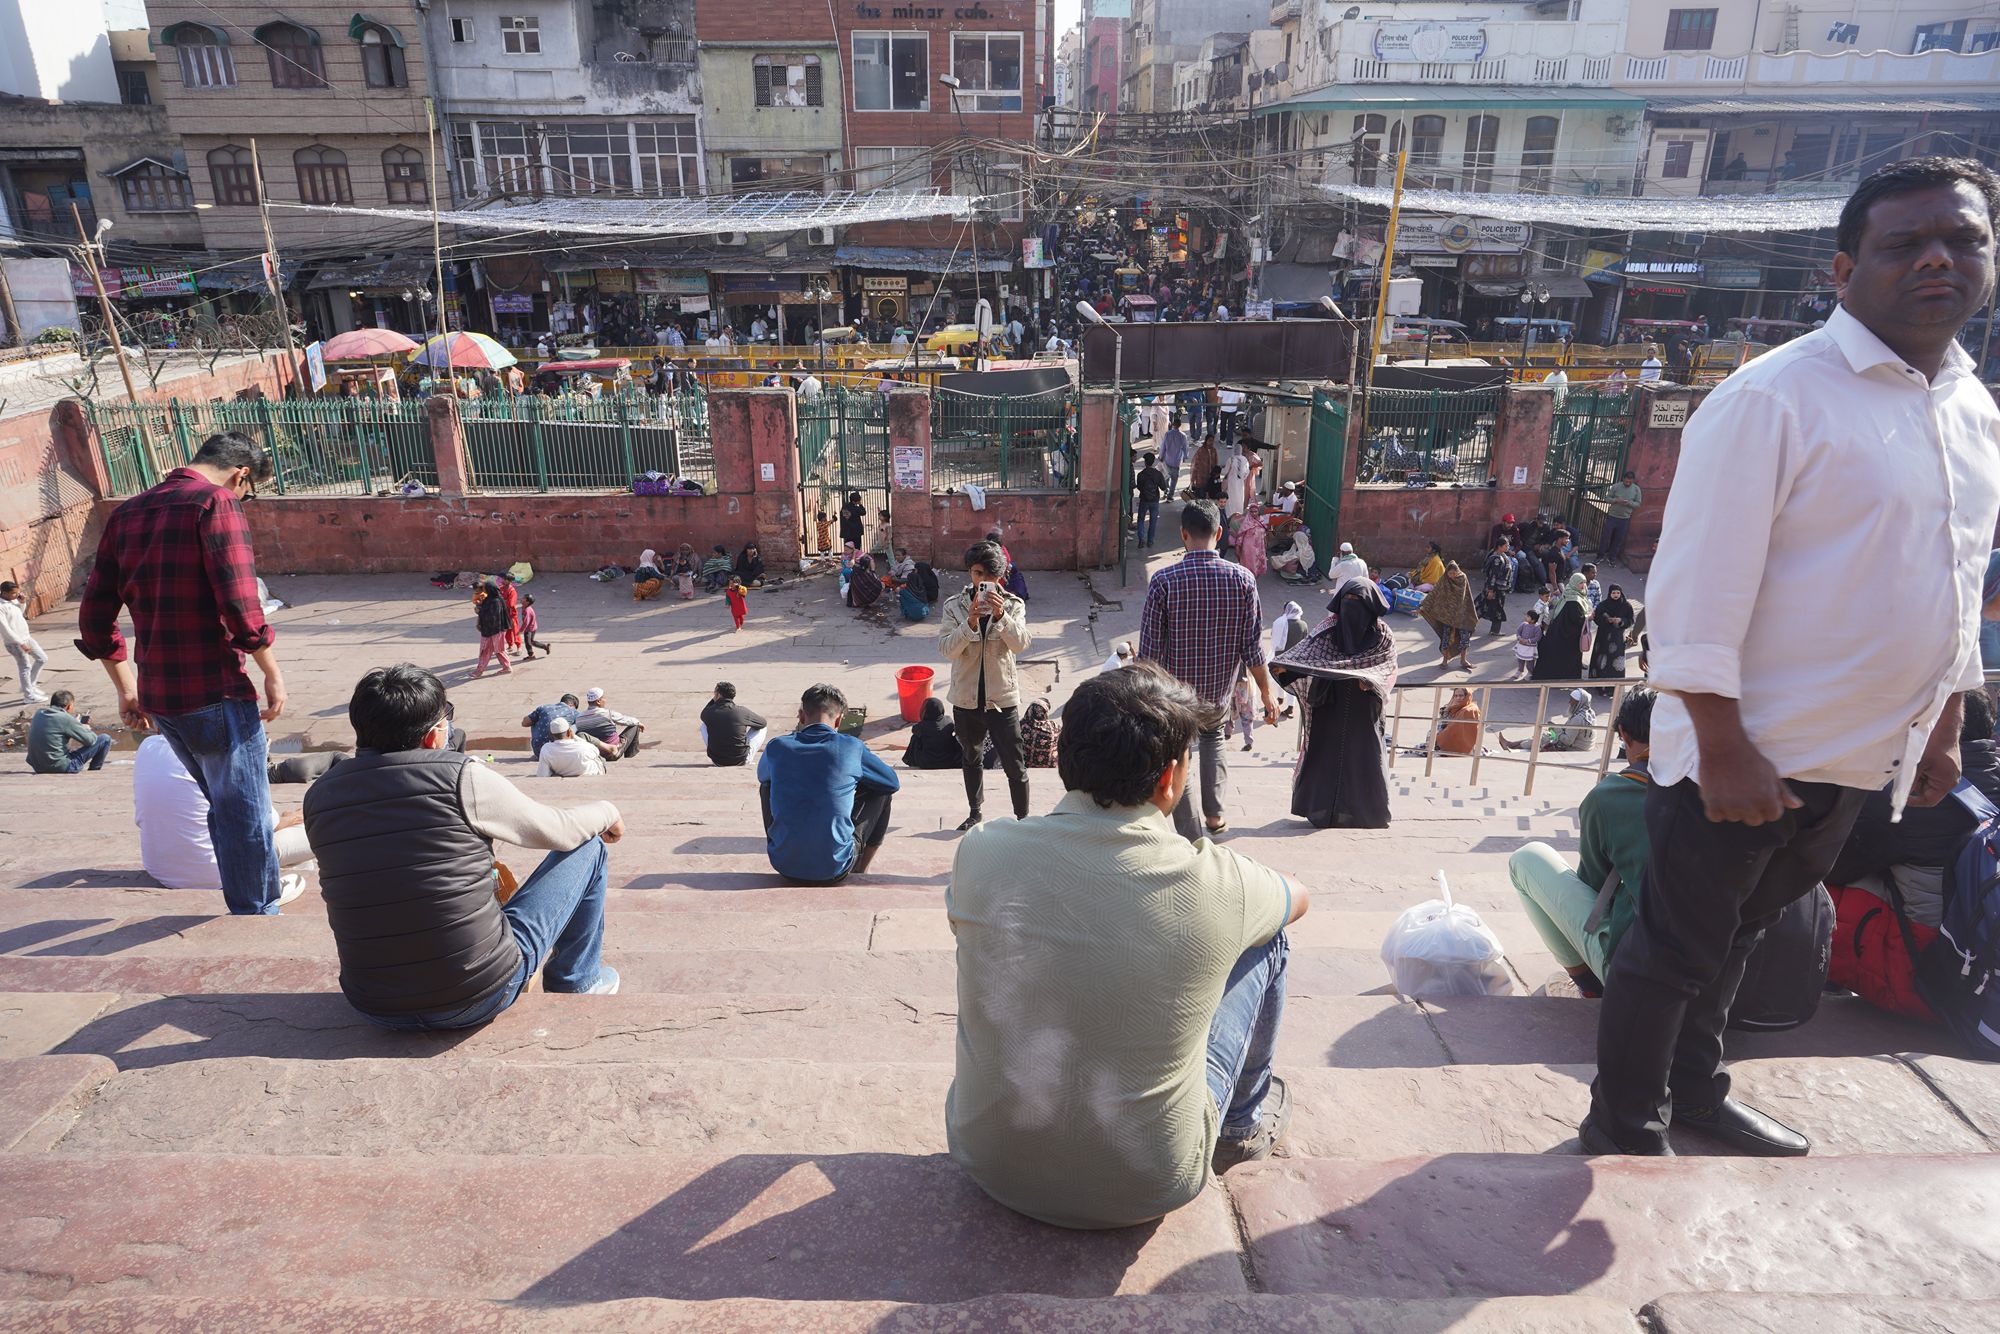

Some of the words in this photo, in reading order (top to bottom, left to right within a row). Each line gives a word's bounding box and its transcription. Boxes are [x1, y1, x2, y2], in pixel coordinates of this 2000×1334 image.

[857, 3, 881, 19] the
[893, 3, 944, 19] minar
[954, 2, 994, 19] cafe.
[1625, 262, 1649, 272] ABDUL
[1649, 262, 1673, 272] MALIK
[1673, 262, 1698, 272] FOODS
[1653, 414, 1685, 423] TOILETS
